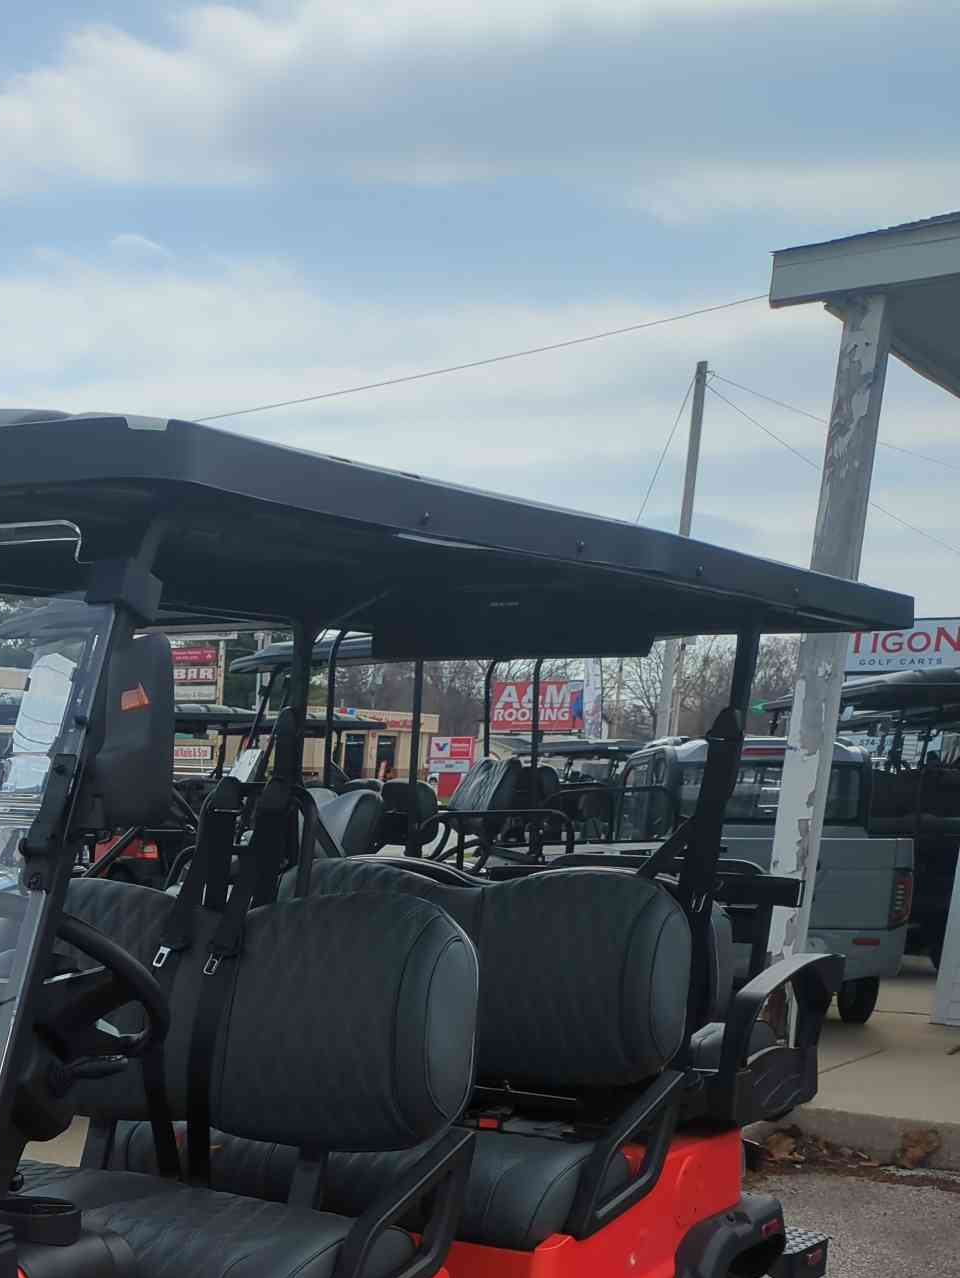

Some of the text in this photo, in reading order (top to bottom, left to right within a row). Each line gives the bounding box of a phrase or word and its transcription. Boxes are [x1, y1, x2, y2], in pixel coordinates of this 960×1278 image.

[850, 626, 960, 654] TIGON
[858, 657, 943, 667] GOLF CARTS
[174, 668, 214, 680] BAR
[495, 684, 572, 708] A&M
